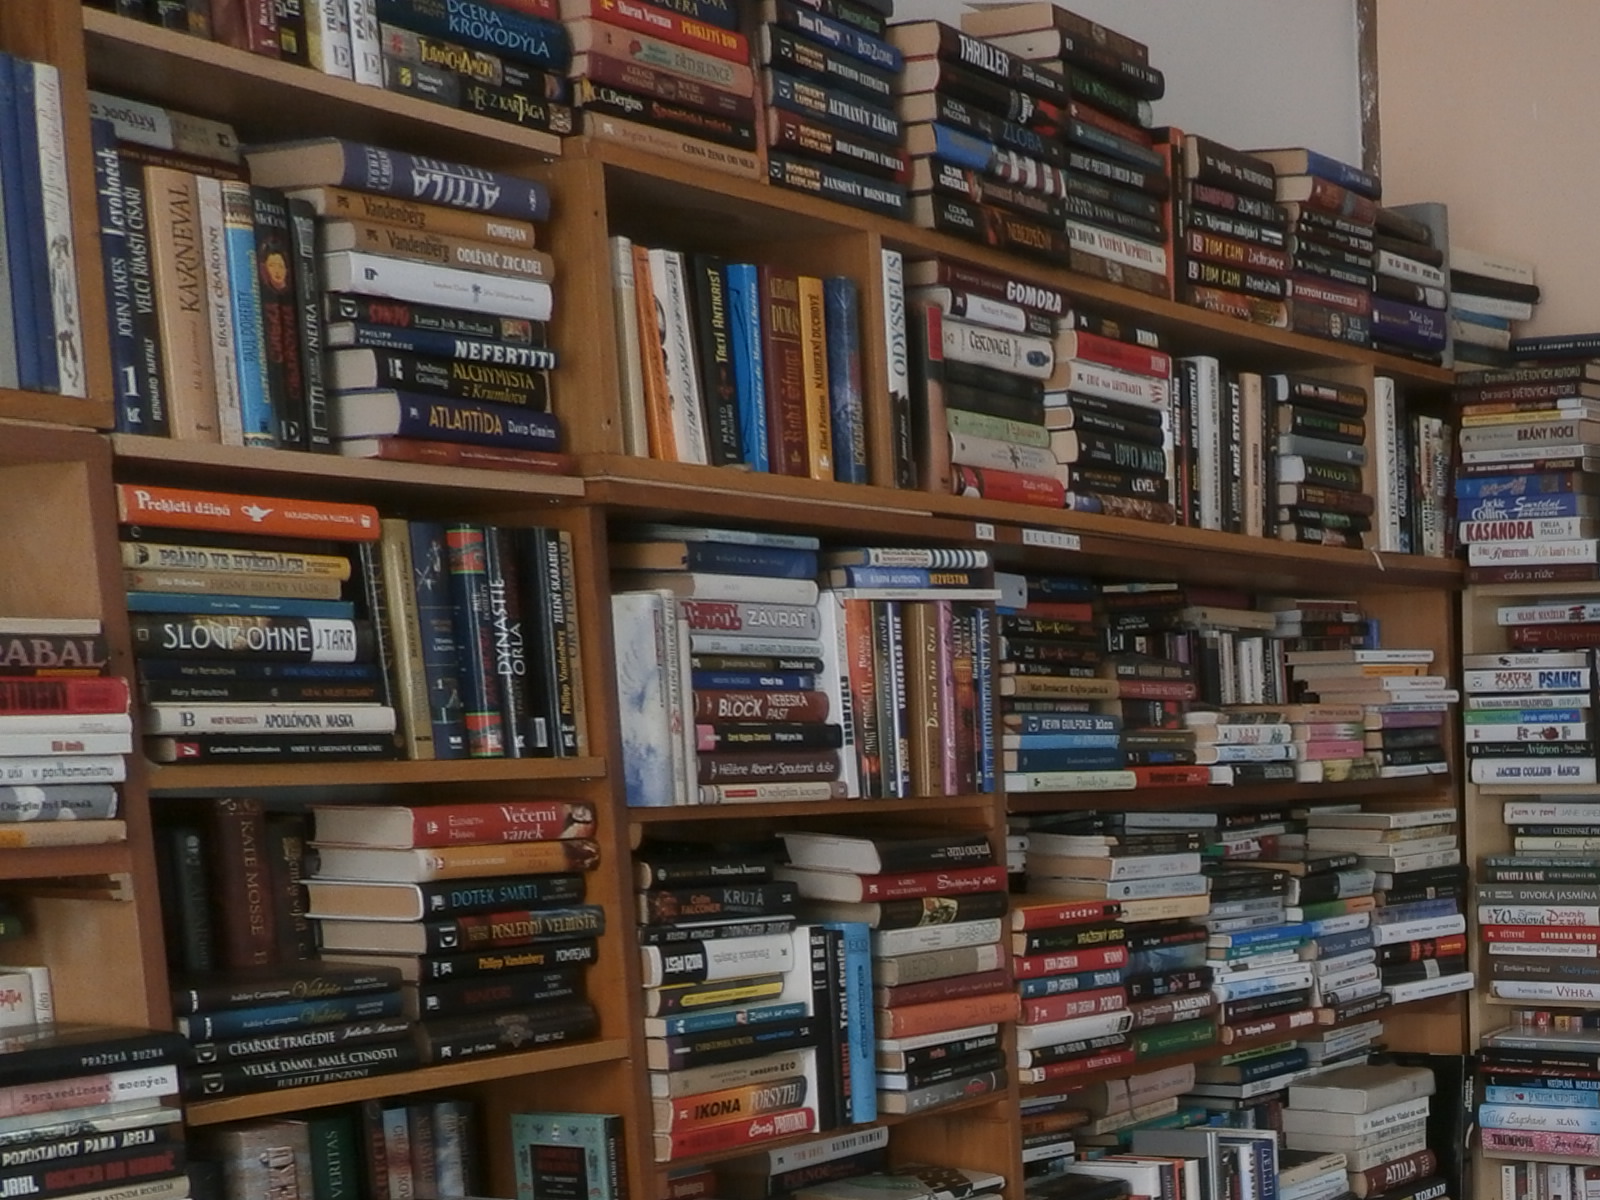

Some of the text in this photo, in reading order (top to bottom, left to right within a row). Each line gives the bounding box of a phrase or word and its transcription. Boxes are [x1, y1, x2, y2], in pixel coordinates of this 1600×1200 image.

[958, 34, 1010, 79] THRILLER
[1006, 281, 1062, 313] GOMORA
[1466, 521, 1534, 541] KASANDRA
[694, 1098, 742, 1120] IKONA
